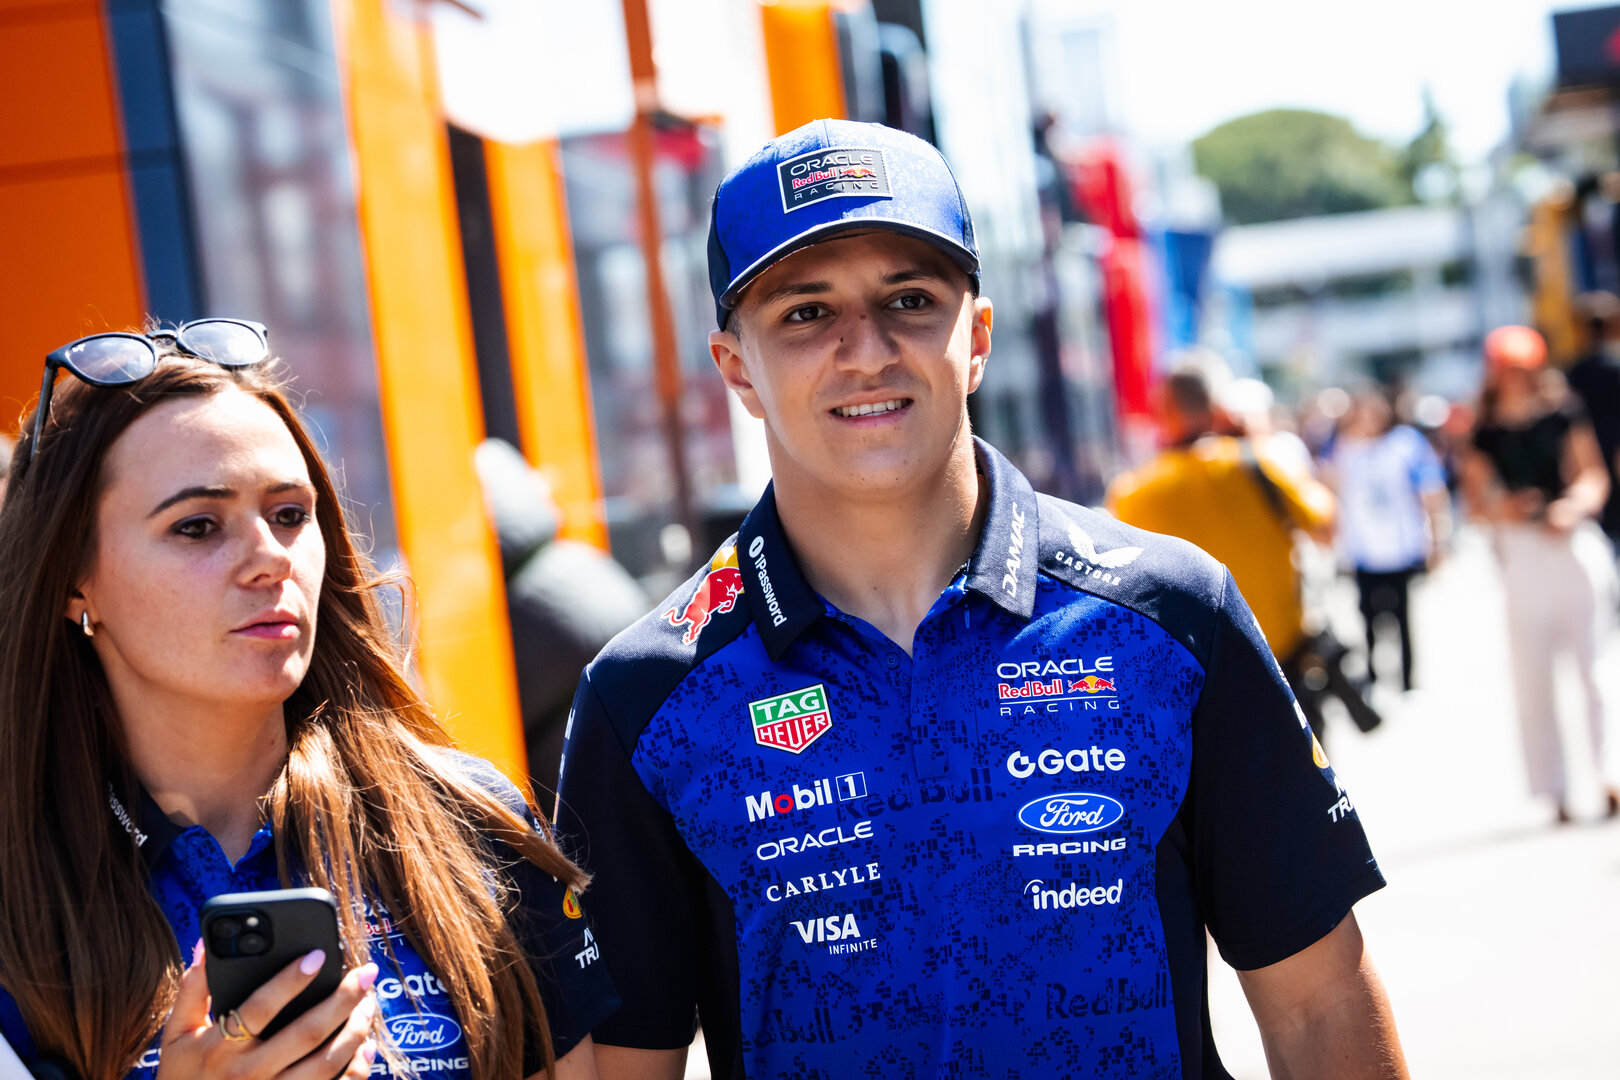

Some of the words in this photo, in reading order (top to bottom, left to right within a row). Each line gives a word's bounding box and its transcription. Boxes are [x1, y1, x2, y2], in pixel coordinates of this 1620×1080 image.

[790, 154, 876, 176] ORACLE
[794, 181, 879, 201] RACING
[1001, 501, 1025, 598] DAMAC
[1055, 550, 1121, 586] CASTORE
[754, 553, 787, 627] 1Password
[996, 656, 1115, 679] ORACLE
[756, 691, 821, 721] TAG
[1000, 700, 1120, 717] RACING
[759, 714, 827, 749] HEUER
[1037, 745, 1126, 776] Gate
[745, 778, 833, 823] Mobil
[844, 775, 857, 798] 1
[1040, 798, 1105, 827] Ford
[756, 820, 874, 861] ORACLE
[1012, 837, 1126, 857] RACING
[766, 862, 881, 902] CARLYLE
[1031, 878, 1123, 910] indeed
[789, 913, 861, 944] VISA
[829, 938, 878, 955] INFINITE
[391, 1019, 445, 1045] Ford
